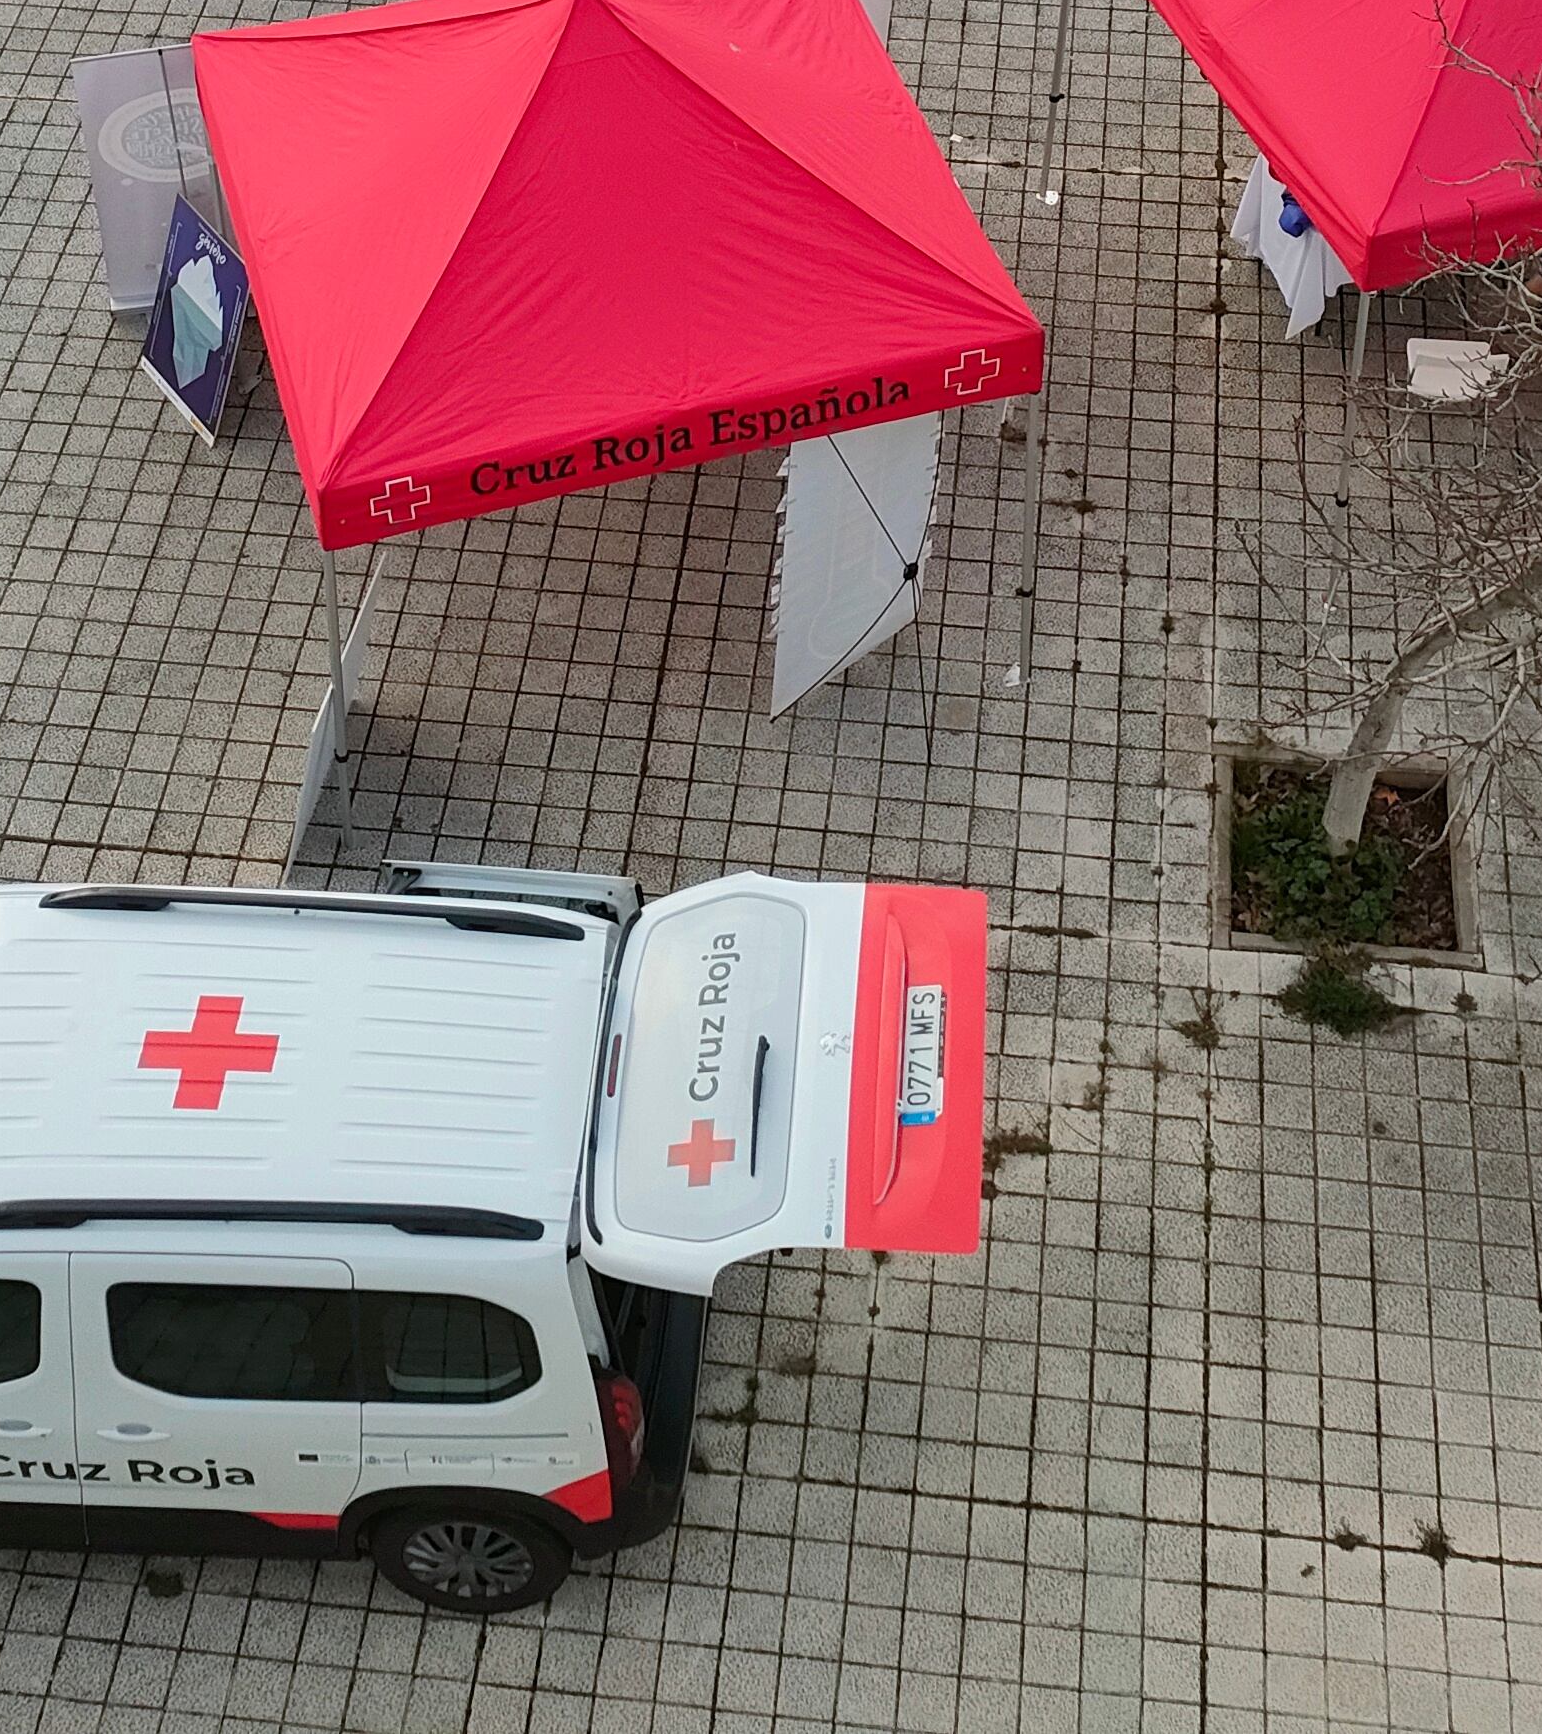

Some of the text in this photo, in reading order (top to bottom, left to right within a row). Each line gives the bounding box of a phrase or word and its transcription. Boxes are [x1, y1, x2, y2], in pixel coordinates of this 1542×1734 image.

[471, 377, 911, 497] Cruz Roja Española
[688, 932, 741, 1102] Cruz Roja
[906, 991, 936, 1106] 0771 MFS
[127, 1459, 256, 1489] Roja
